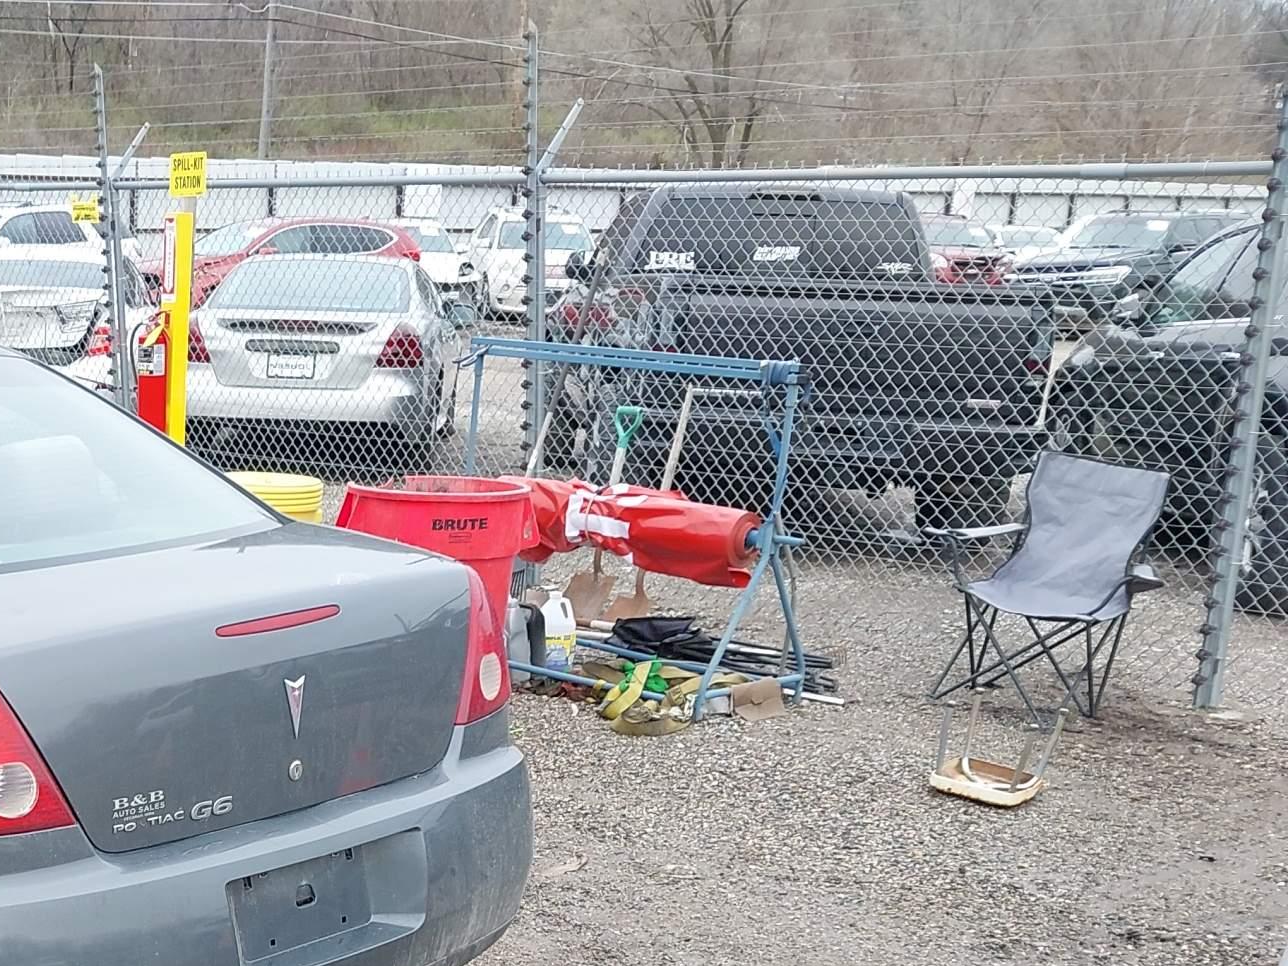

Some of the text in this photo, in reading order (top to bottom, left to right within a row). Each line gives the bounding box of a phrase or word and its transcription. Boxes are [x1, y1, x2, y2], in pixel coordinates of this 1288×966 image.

[173, 157, 204, 171] SPILL-KIT
[174, 175, 201, 189] STATION
[432, 517, 488, 531] BRUTE
[112, 790, 165, 811] B&B
[190, 795, 233, 820] G6
[112, 808, 136, 819] AUTO
[138, 801, 166, 814] SALES
